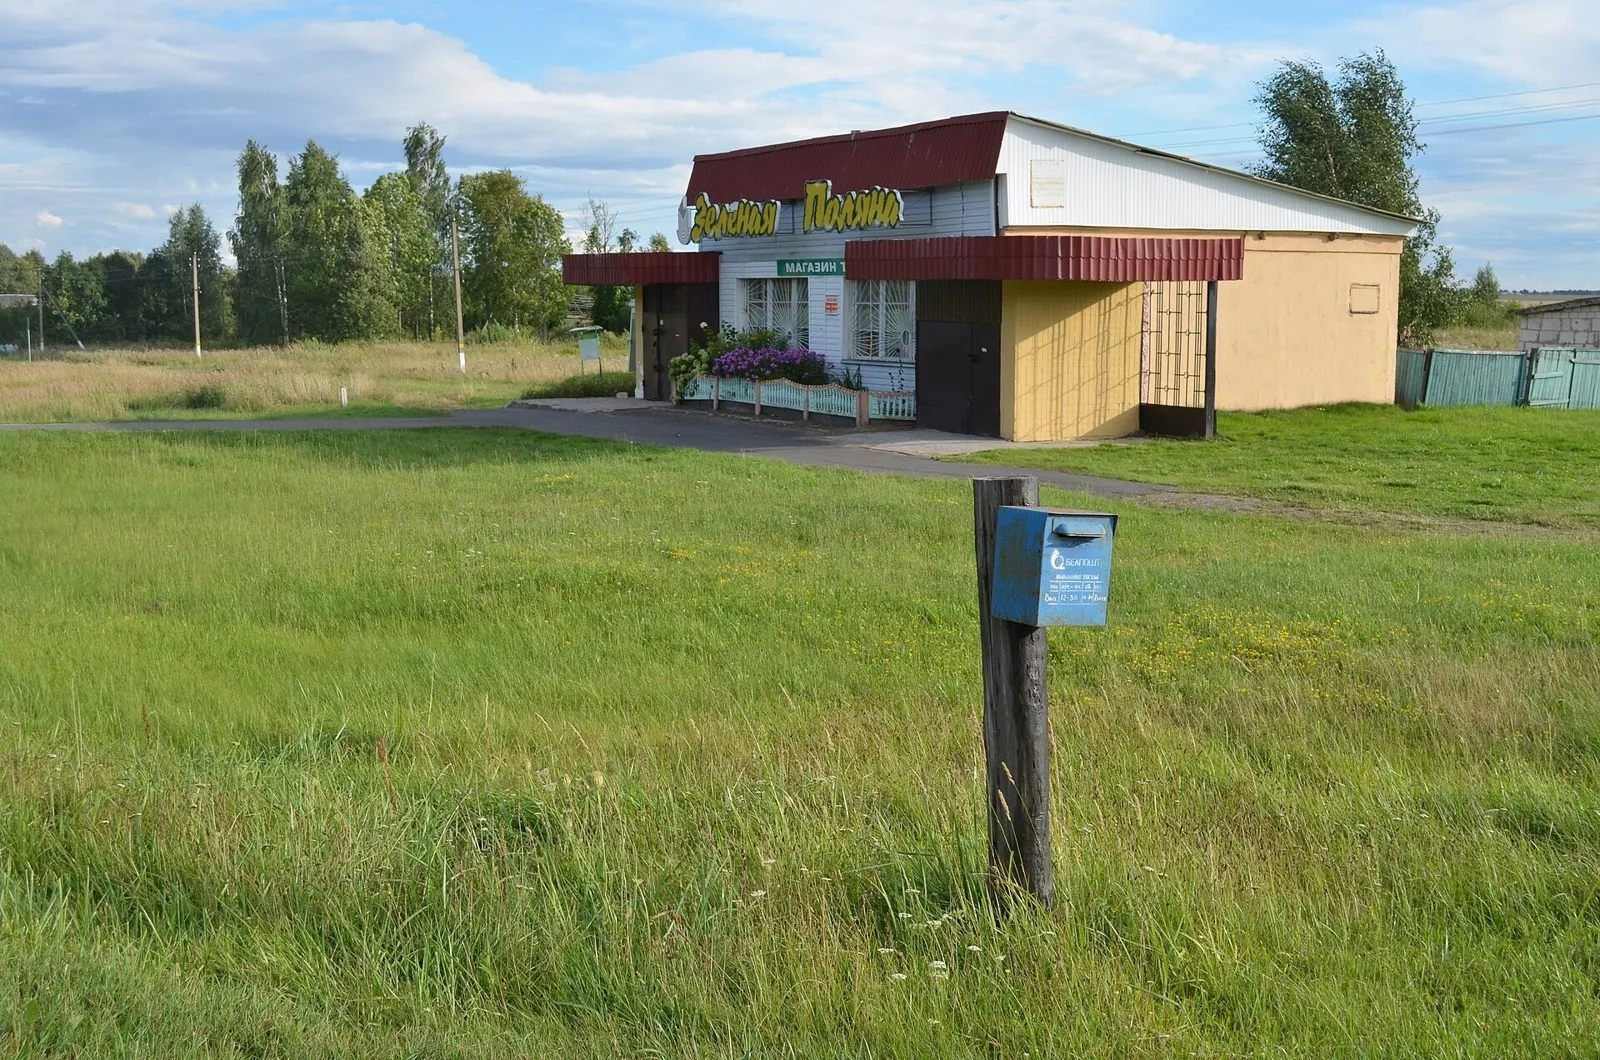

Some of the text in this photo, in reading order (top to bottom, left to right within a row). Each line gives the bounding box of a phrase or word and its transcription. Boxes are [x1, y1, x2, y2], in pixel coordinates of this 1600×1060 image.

[804, 180, 902, 233] Поляна
[785, 261, 837, 273] МАГАЗИН
[1066, 558, 1102, 566] БЕЛПОШТ
